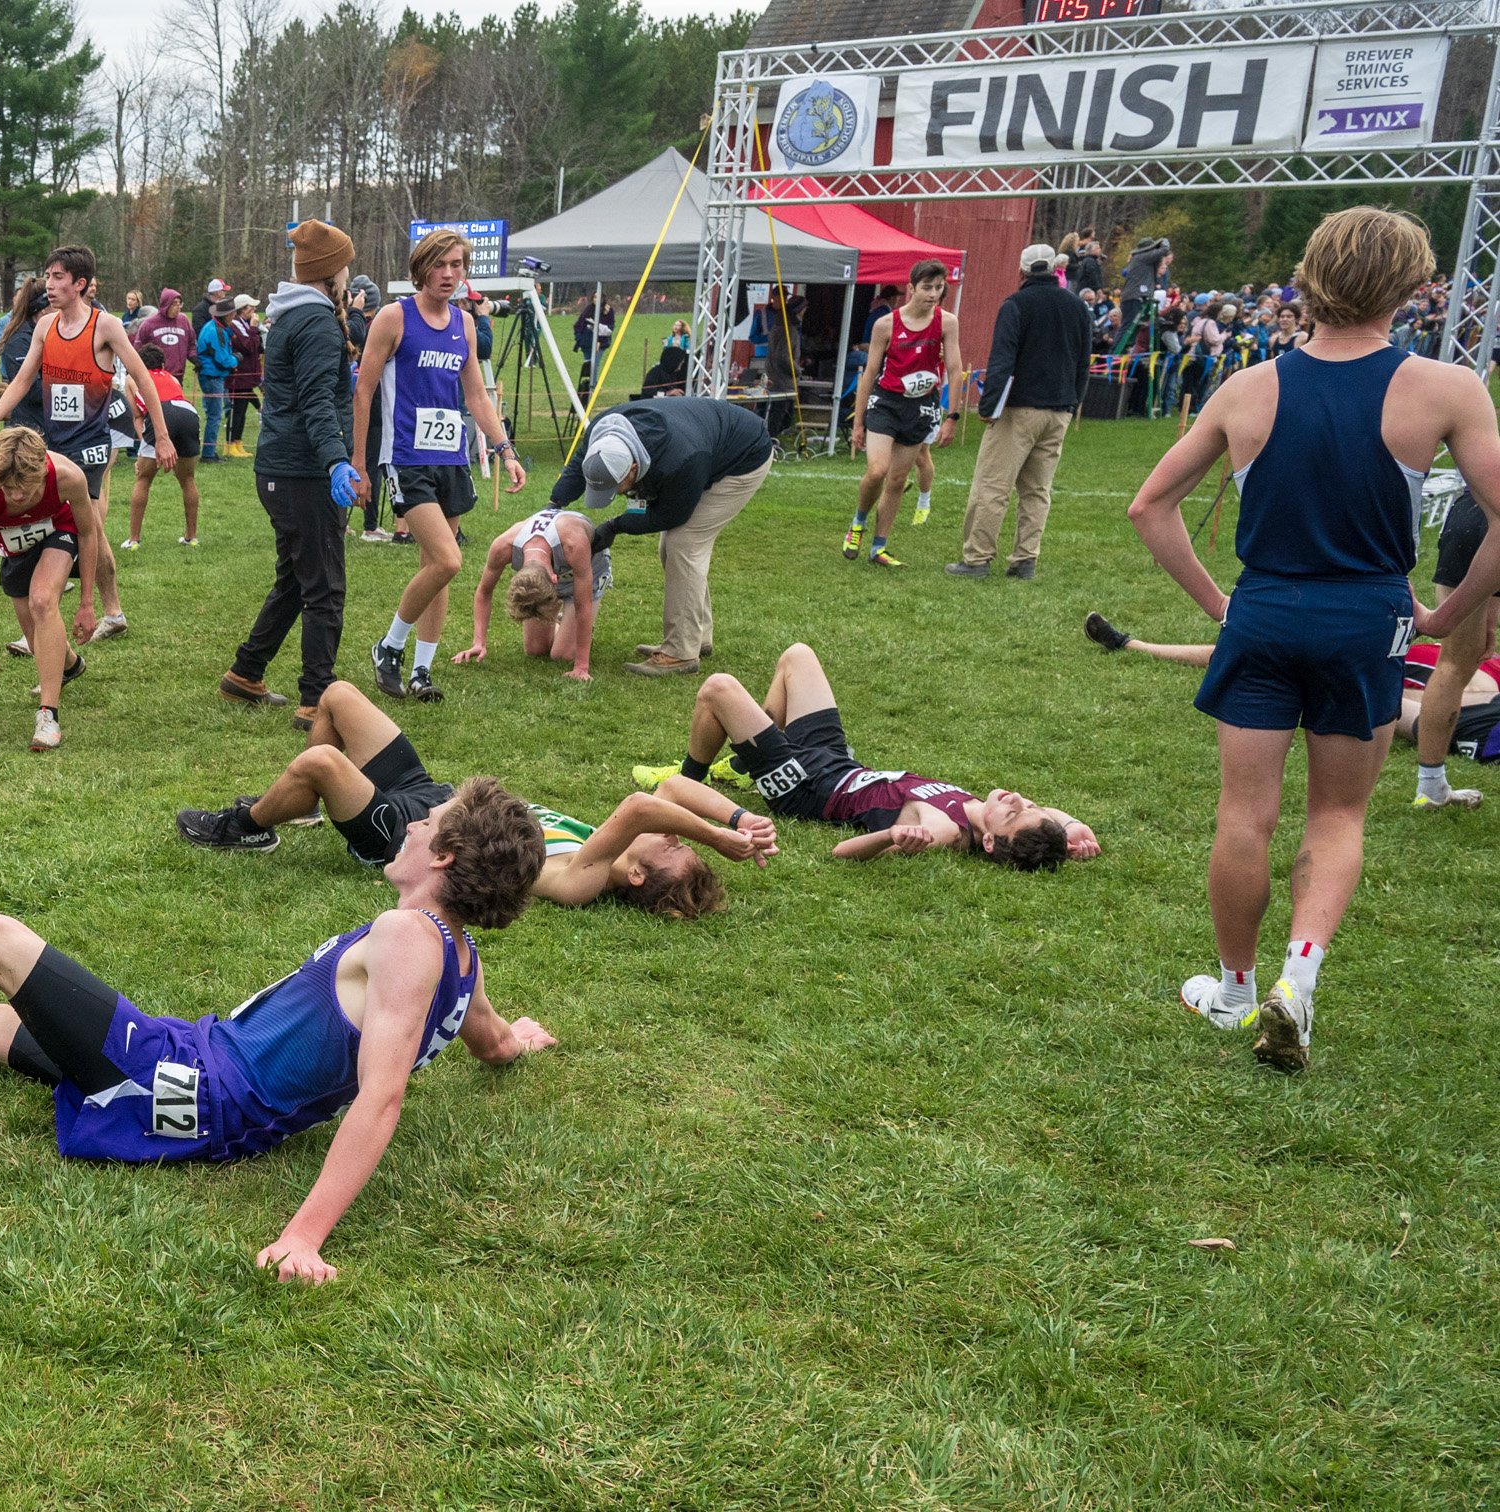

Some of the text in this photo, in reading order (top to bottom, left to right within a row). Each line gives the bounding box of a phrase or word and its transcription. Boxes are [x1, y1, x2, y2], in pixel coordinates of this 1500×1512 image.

[1345, 48, 1413, 62] BREWER
[1346, 62, 1404, 76] TIMING
[1337, 75, 1409, 91] SERVICES
[926, 58, 1268, 156] FINISH
[1345, 110, 1410, 130] LYNX
[471, 223, 488, 233] Class
[490, 223, 495, 232] A
[418, 350, 463, 371] HAWKS
[909, 378, 933, 393] 765
[53, 396, 79, 412] 654
[422, 421, 455, 441] 723
[10, 528, 47, 550] 757
[760, 762, 802, 798] 693
[240, 831, 270, 843] HOKA
[156, 1072, 196, 1131] 712
